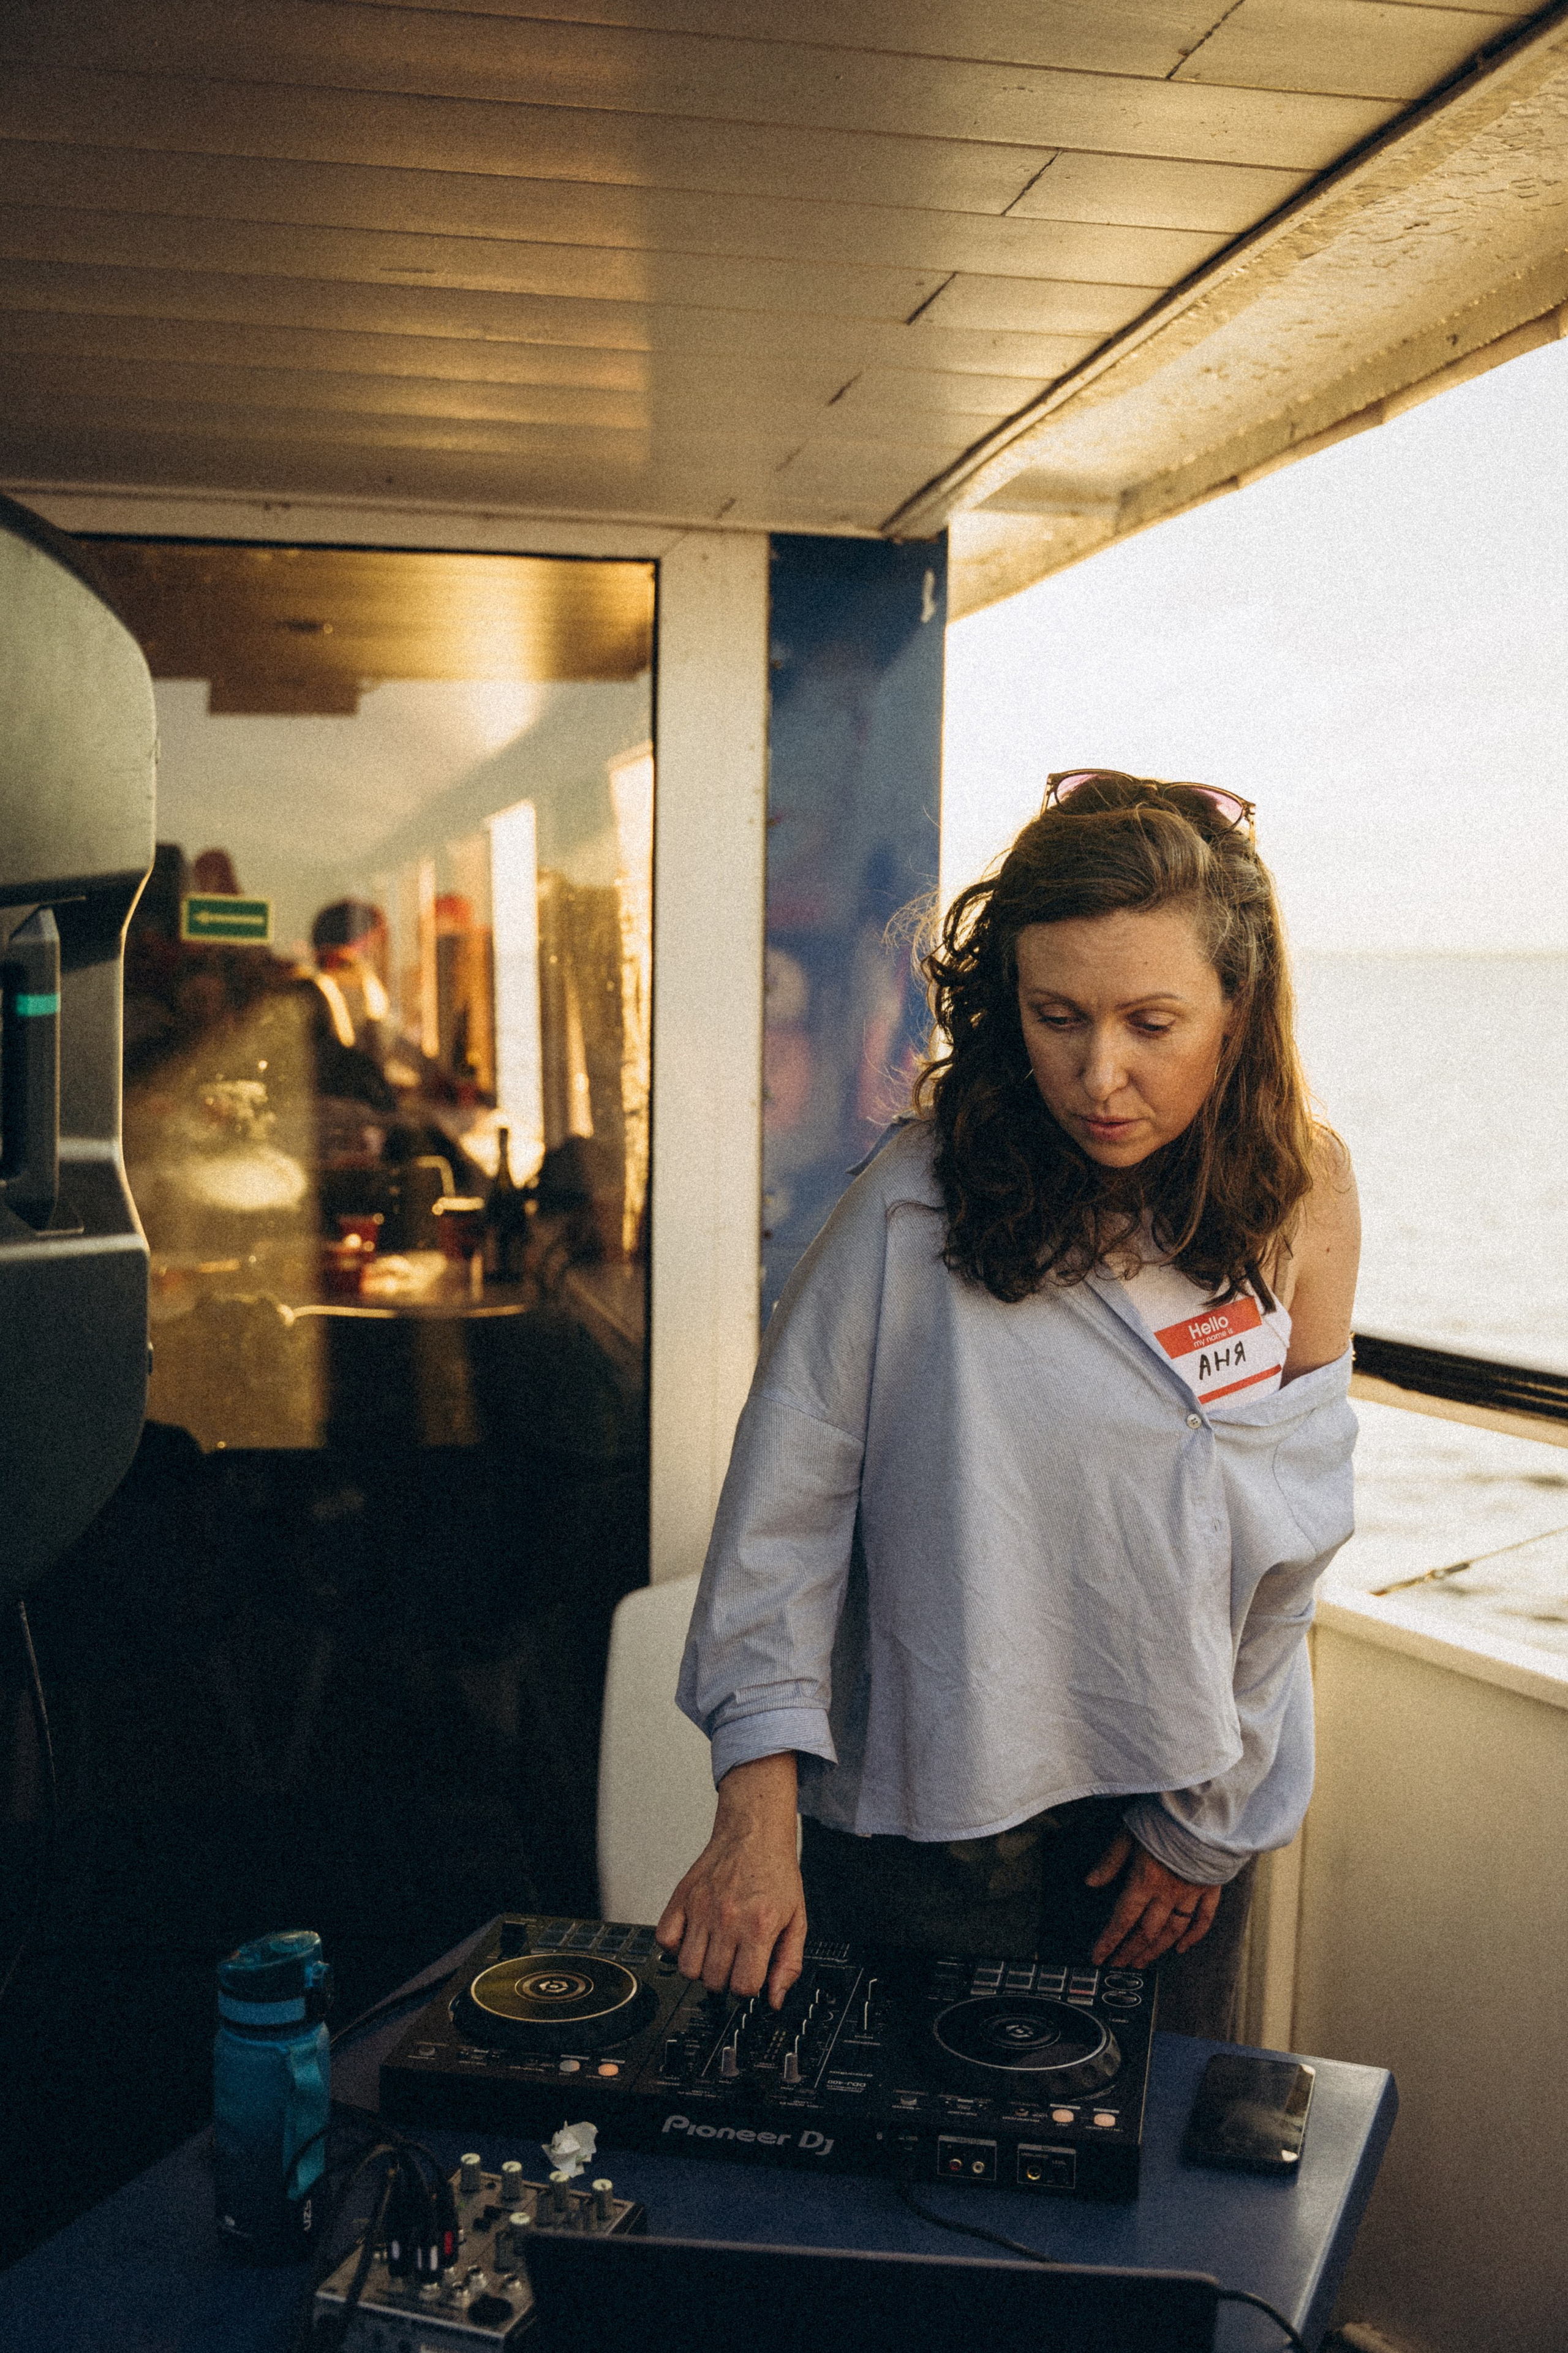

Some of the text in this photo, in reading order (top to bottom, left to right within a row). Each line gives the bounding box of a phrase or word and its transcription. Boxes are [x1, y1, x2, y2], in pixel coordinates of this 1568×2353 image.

[1188, 1315, 1229, 1340] Hello
[1193, 1339, 1205, 1348] my
[1206, 1331, 1227, 1342] name
[1199, 1340, 1246, 1380] АНЯ
[662, 2115, 835, 2156] Pioneer DJ
